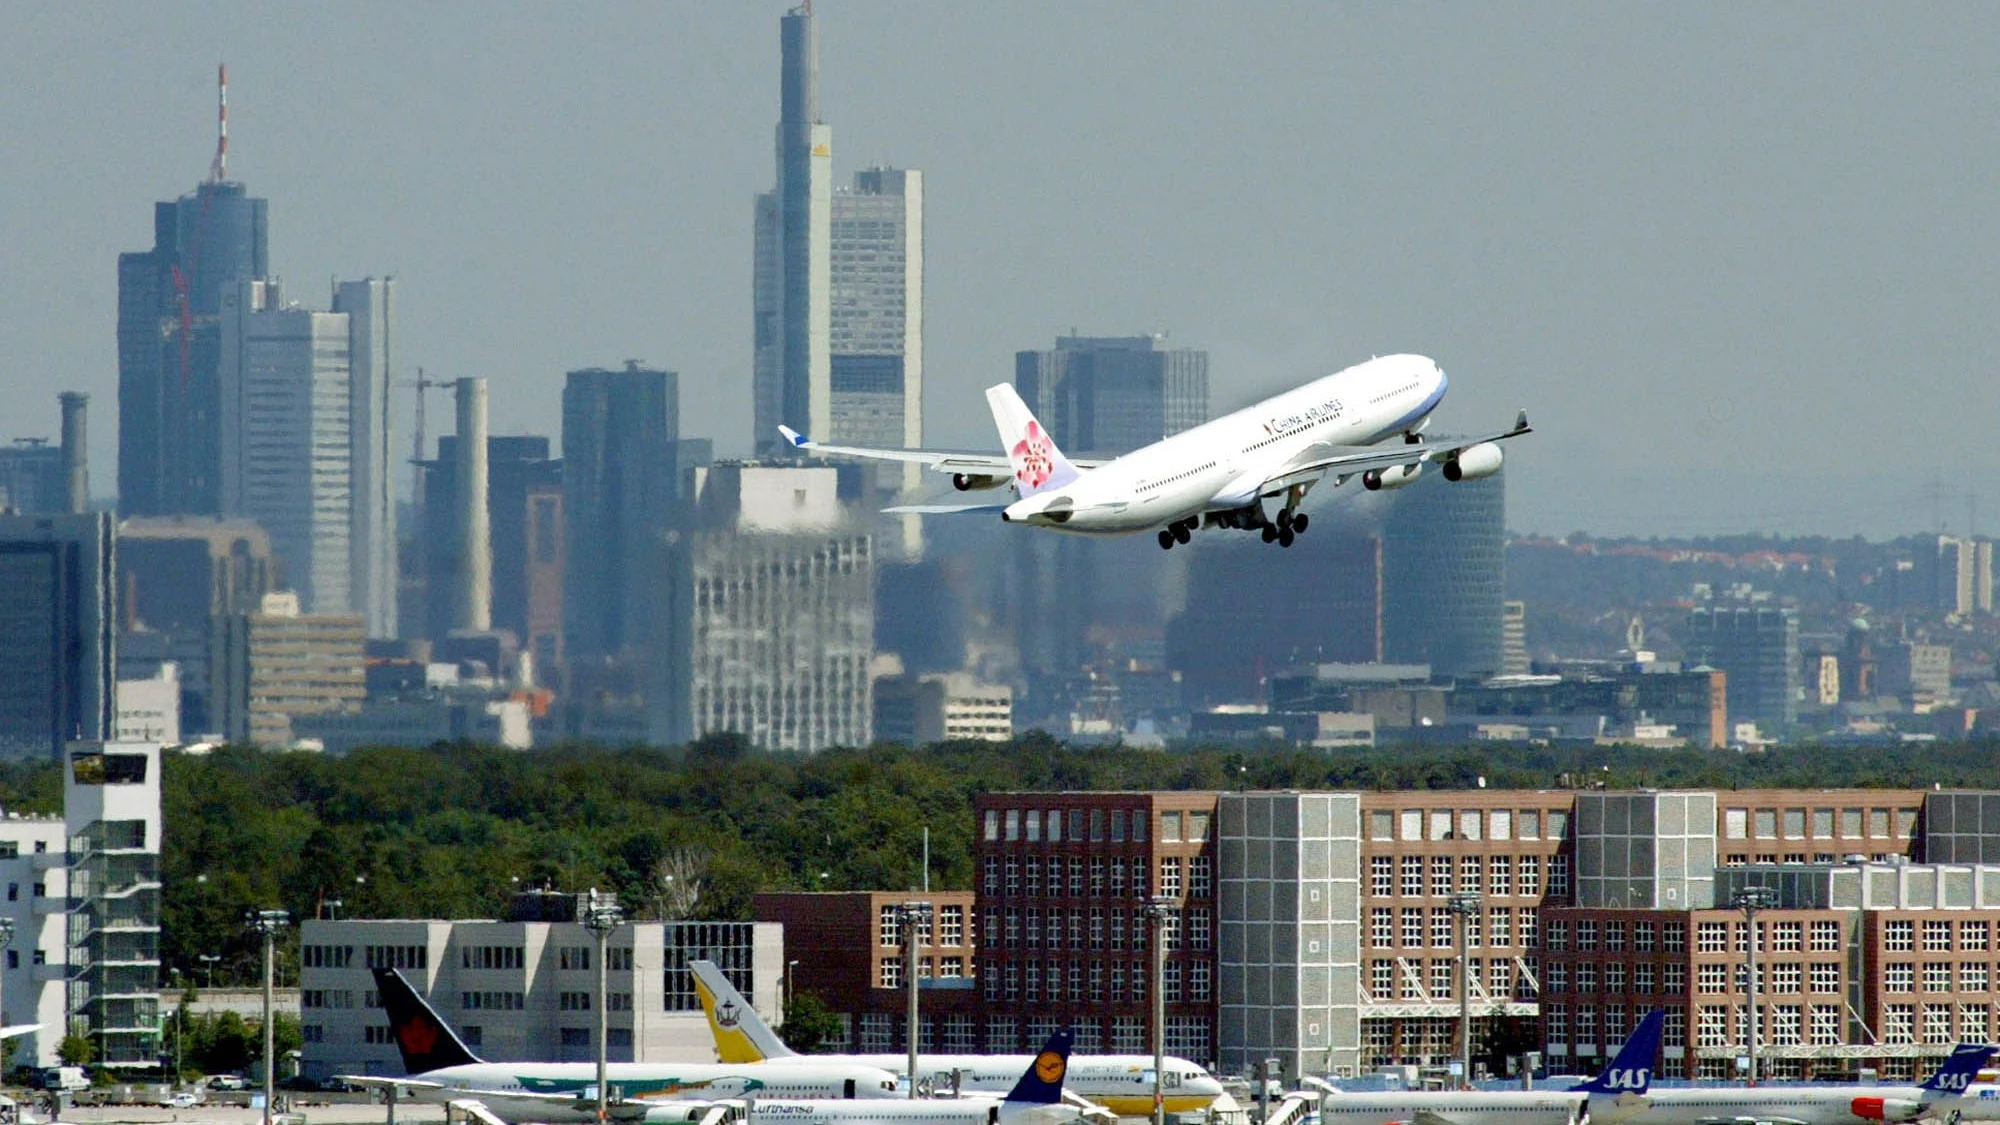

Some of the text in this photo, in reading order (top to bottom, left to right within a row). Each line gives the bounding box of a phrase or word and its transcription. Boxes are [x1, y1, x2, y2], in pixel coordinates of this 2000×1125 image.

[1603, 1068, 1649, 1088] SAS
[1935, 1073, 1971, 1089] SAS
[751, 1104, 814, 1114] Lufthansa
